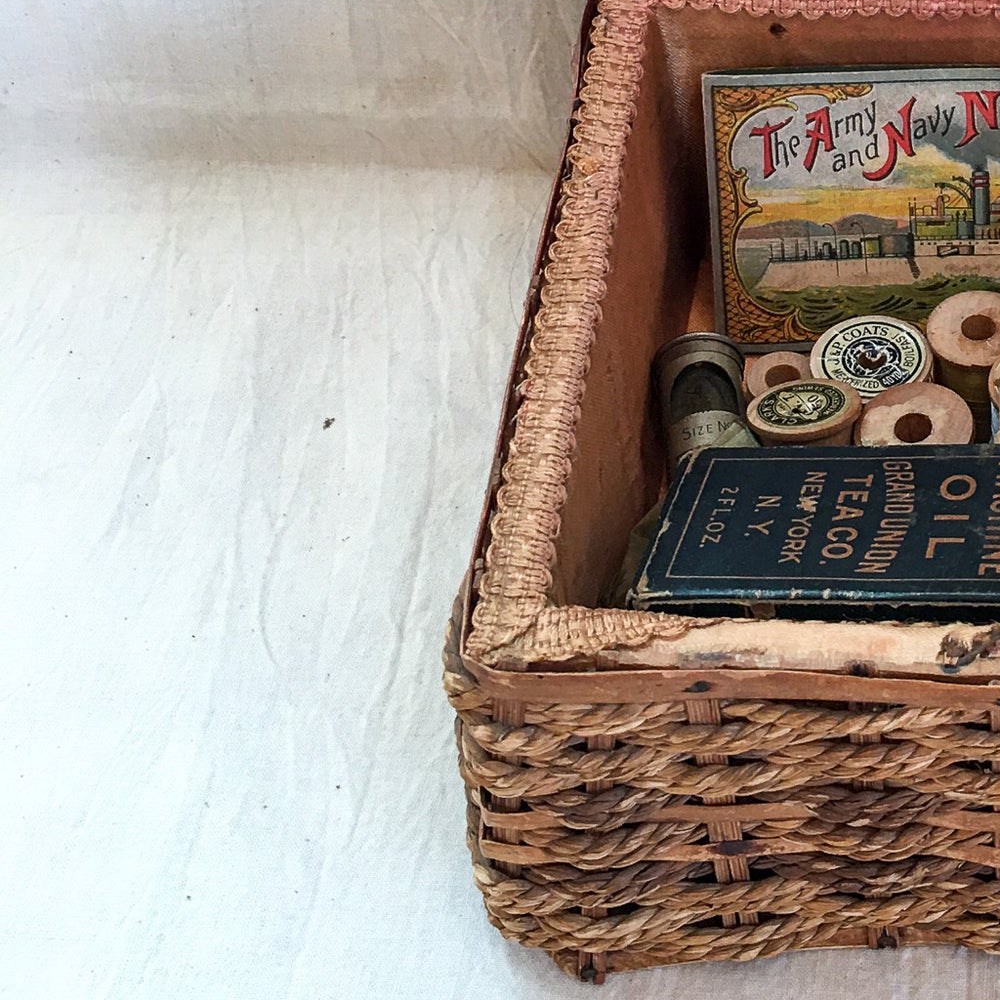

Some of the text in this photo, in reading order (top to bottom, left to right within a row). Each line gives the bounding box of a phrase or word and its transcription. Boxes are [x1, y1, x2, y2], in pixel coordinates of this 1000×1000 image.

[749, 116, 801, 179] The
[802, 101, 877, 173] Army
[832, 134, 880, 172] and
[862, 96, 956, 181] Navy
[842, 325, 890, 342] COATS
[682, 423, 713, 440] SIZE
[777, 471, 827, 563] NEW YORK
[819, 474, 874, 565] TEA CO.
[854, 461, 915, 574] GRAND UNION
[925, 474, 977, 559] OIL
